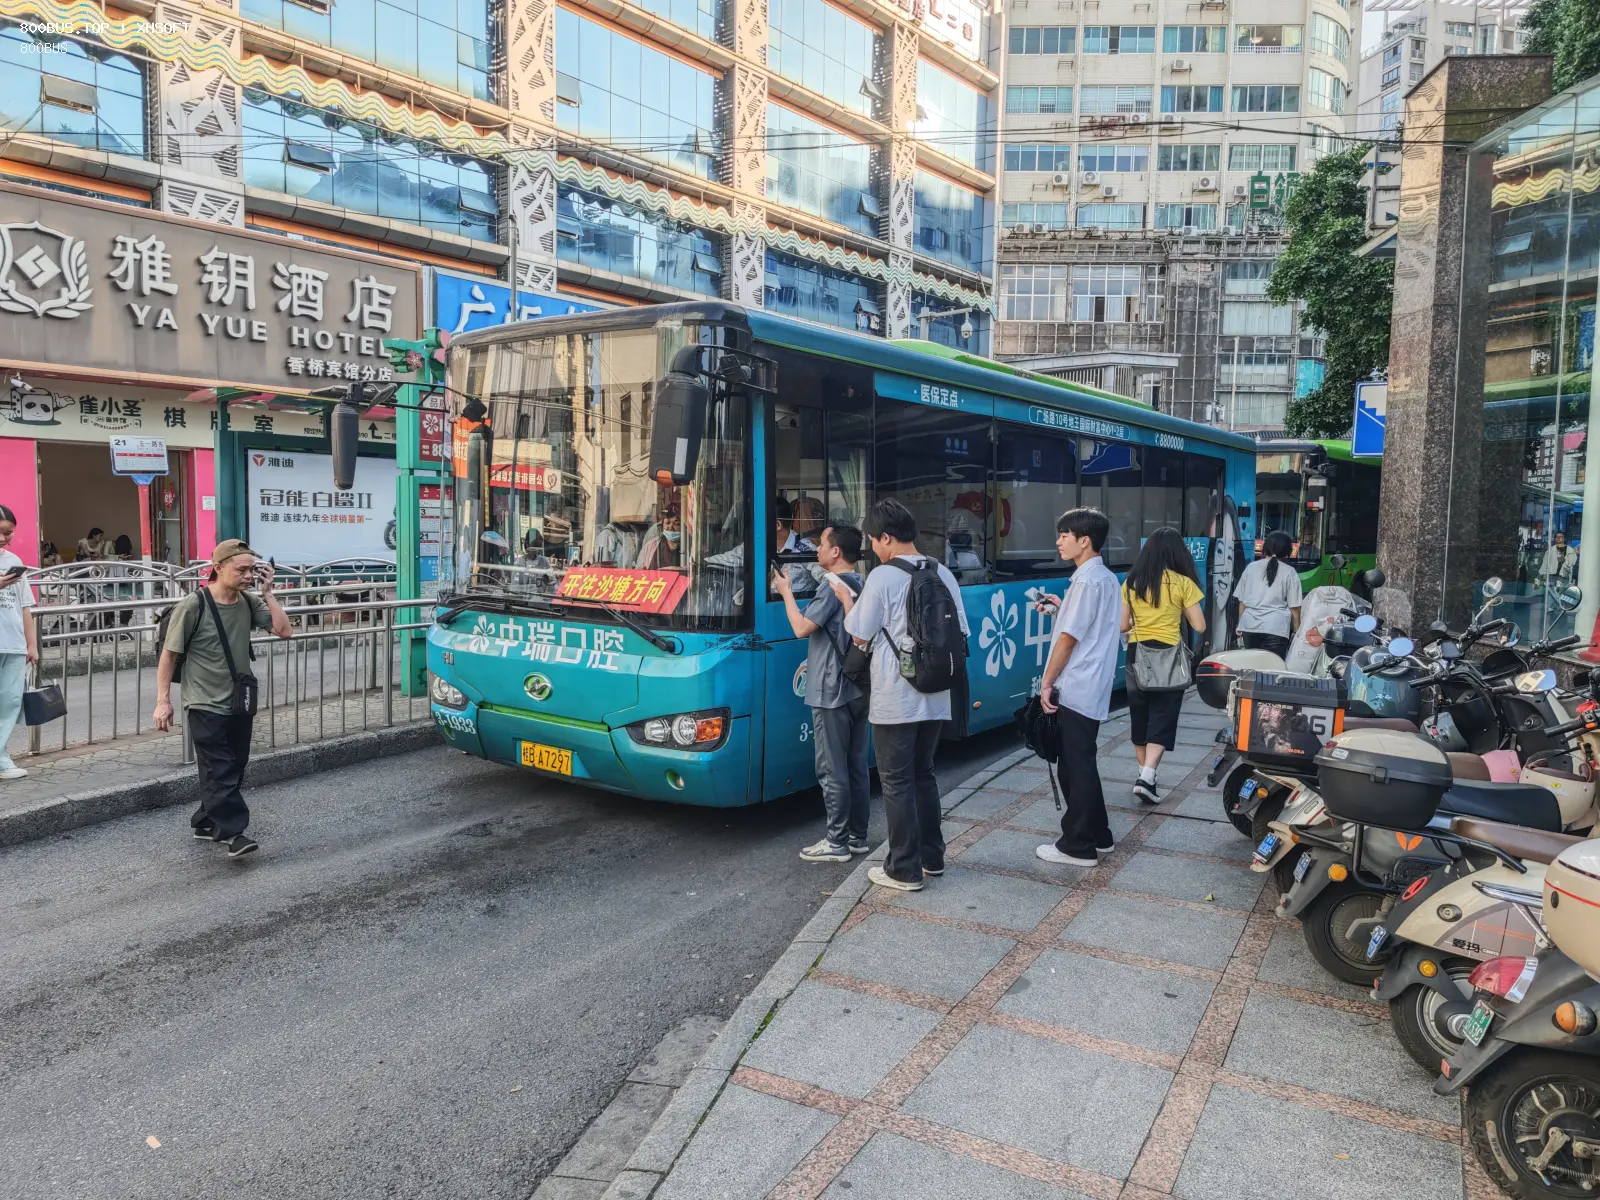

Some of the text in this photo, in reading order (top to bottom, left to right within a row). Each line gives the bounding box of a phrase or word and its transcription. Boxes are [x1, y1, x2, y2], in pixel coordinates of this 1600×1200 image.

[109, 234, 397, 333] 雅钥酒店
[128, 303, 393, 359] YA YUE HOTEL
[287, 356, 393, 381] 香桥宾馆分店
[79, 394, 143, 418] 雀小圣
[920, 383, 959, 409] 医保定点
[1159, 432, 1184, 451] 8800000
[268, 457, 295, 468] 雅迪
[260, 488, 309, 508] 冠能
[260, 512, 374, 524] 雅迪 连续九年全球销量第一
[563, 574, 668, 605] 开往沙塘方向
[495, 617, 625, 671] 中瑞口腔
[434, 710, 477, 735] 3-1933
[799, 722, 815, 742] 3-
[1452, 937, 1481, 953] 爱玛
